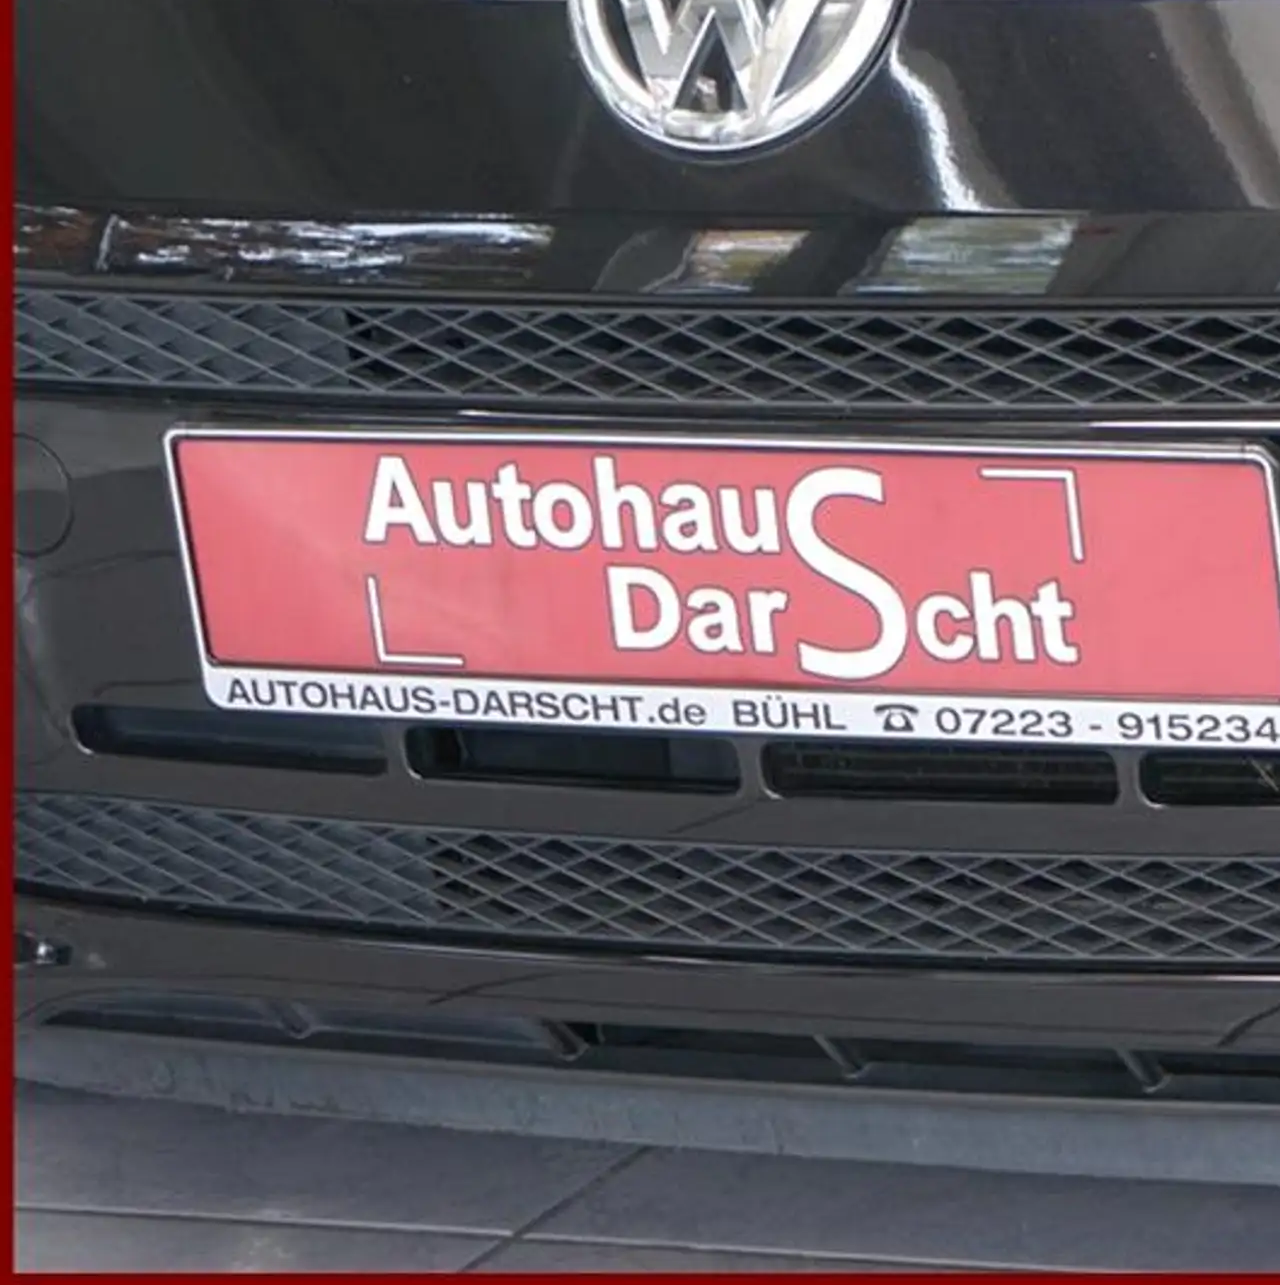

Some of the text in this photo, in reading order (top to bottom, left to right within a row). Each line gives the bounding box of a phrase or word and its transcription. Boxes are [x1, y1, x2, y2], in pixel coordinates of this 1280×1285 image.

[226, 678, 707, 725] AUTOHAUS-DARSCHT.de
[732, 695, 847, 729] BÜHL
[934, 706, 1074, 738] 07223
